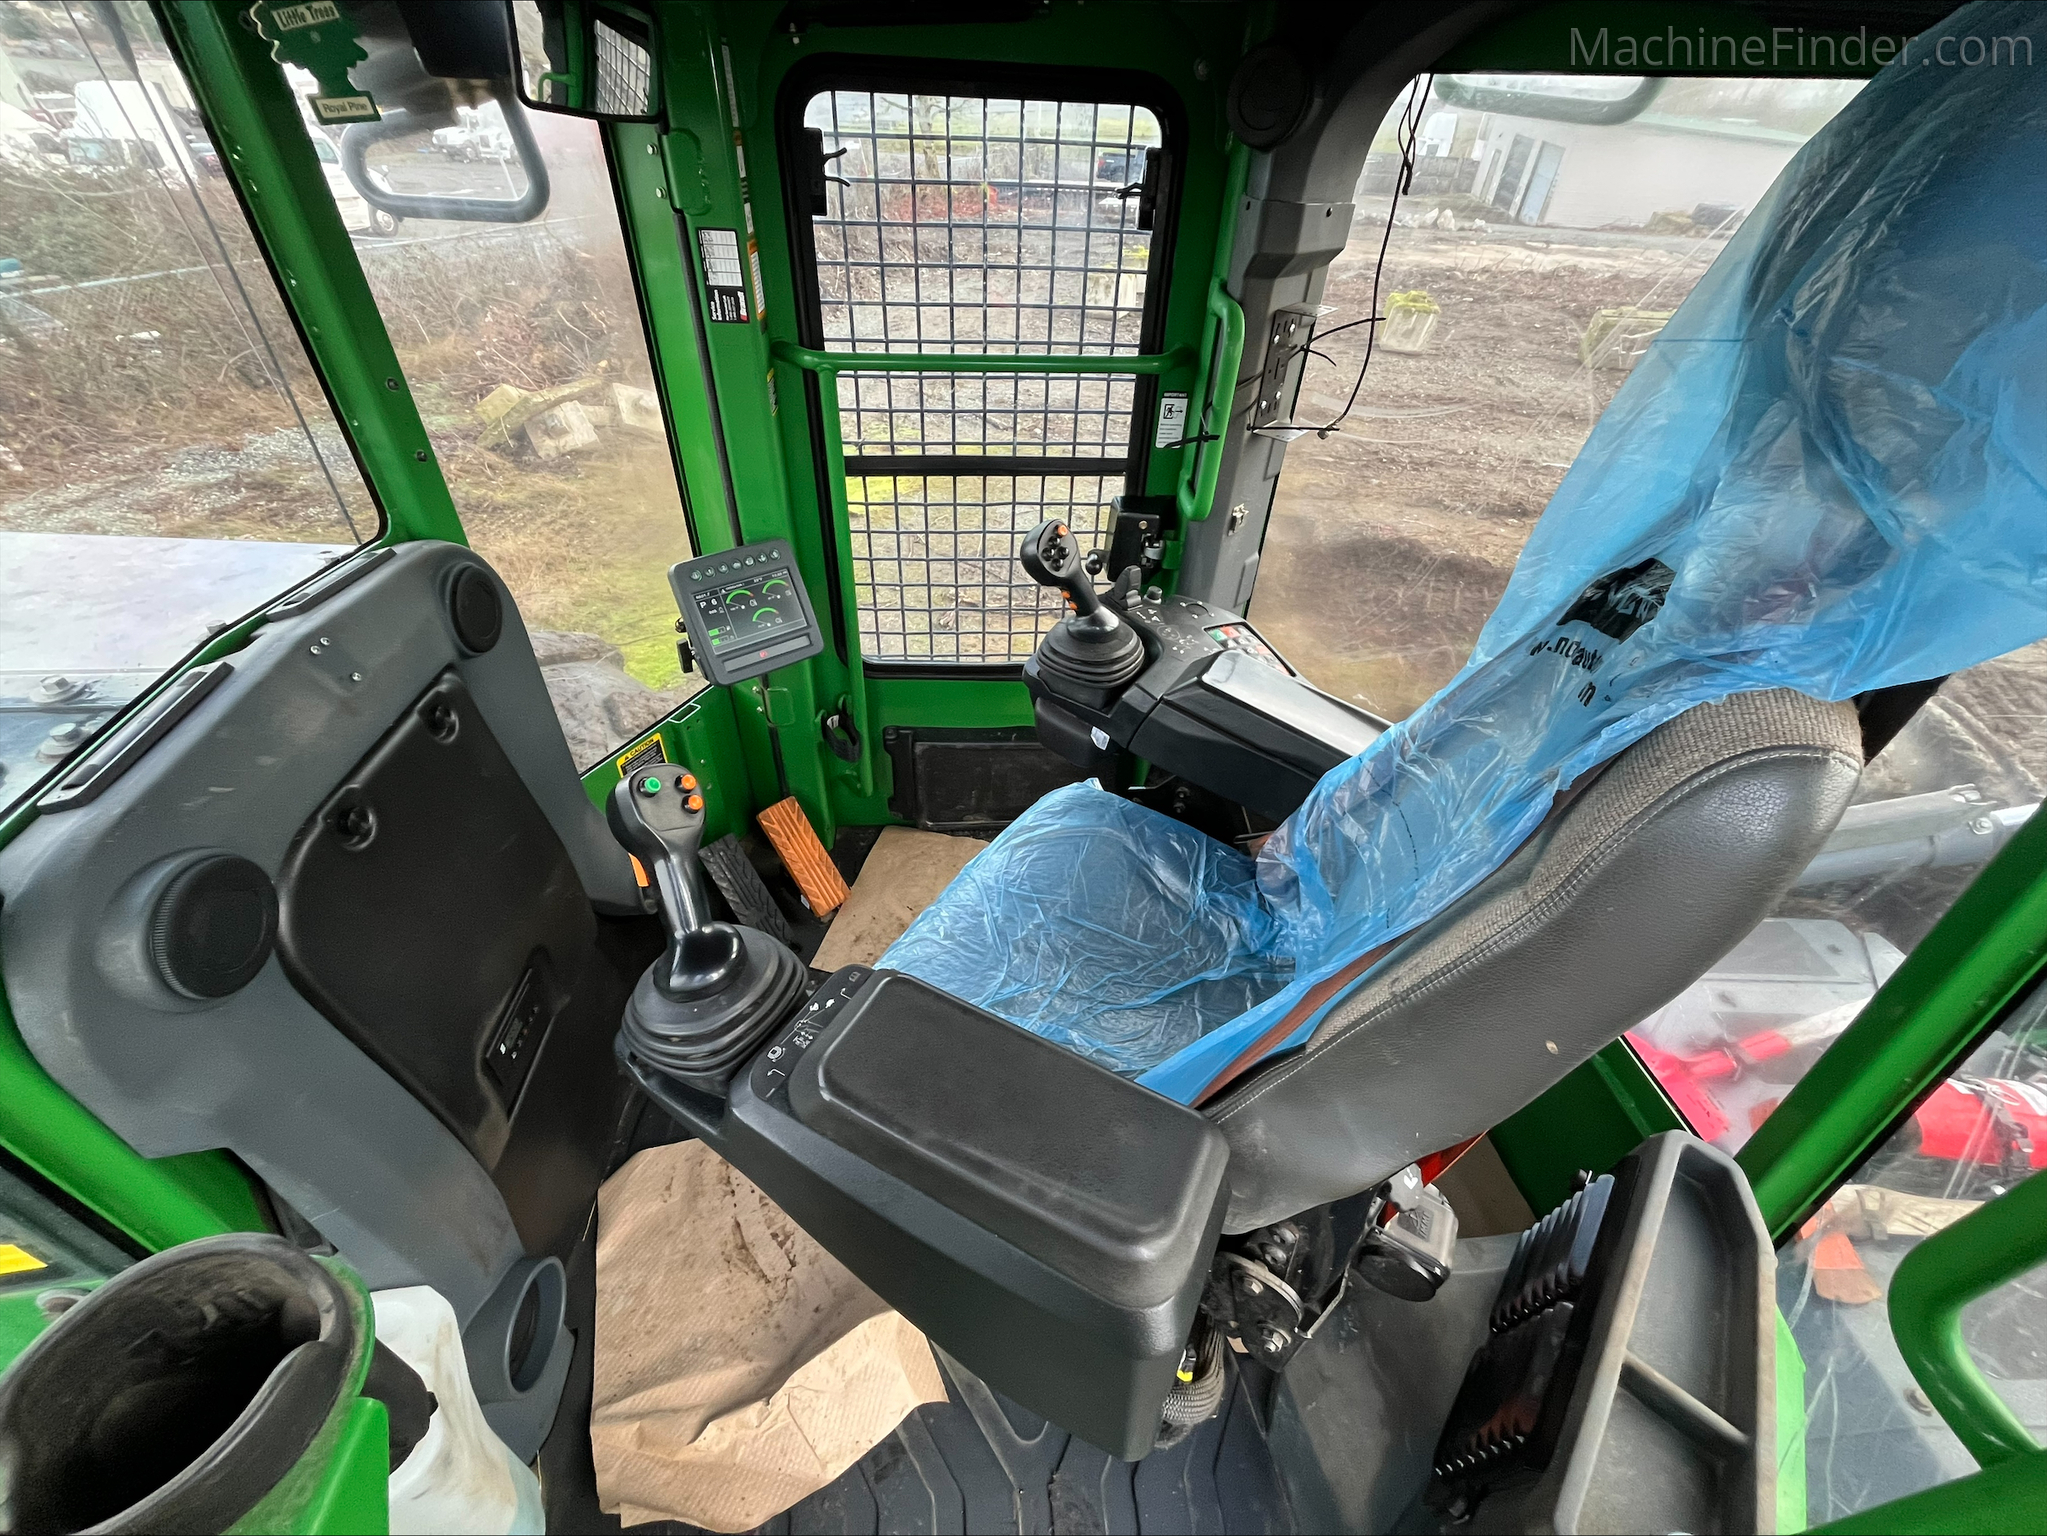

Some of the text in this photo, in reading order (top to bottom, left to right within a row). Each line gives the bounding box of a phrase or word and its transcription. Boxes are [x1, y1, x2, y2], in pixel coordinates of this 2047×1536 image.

[277, 4, 336, 28] Little Trees
[321, 101, 368, 114] Royal Pine
[629, 738, 655, 756] CAUTION
